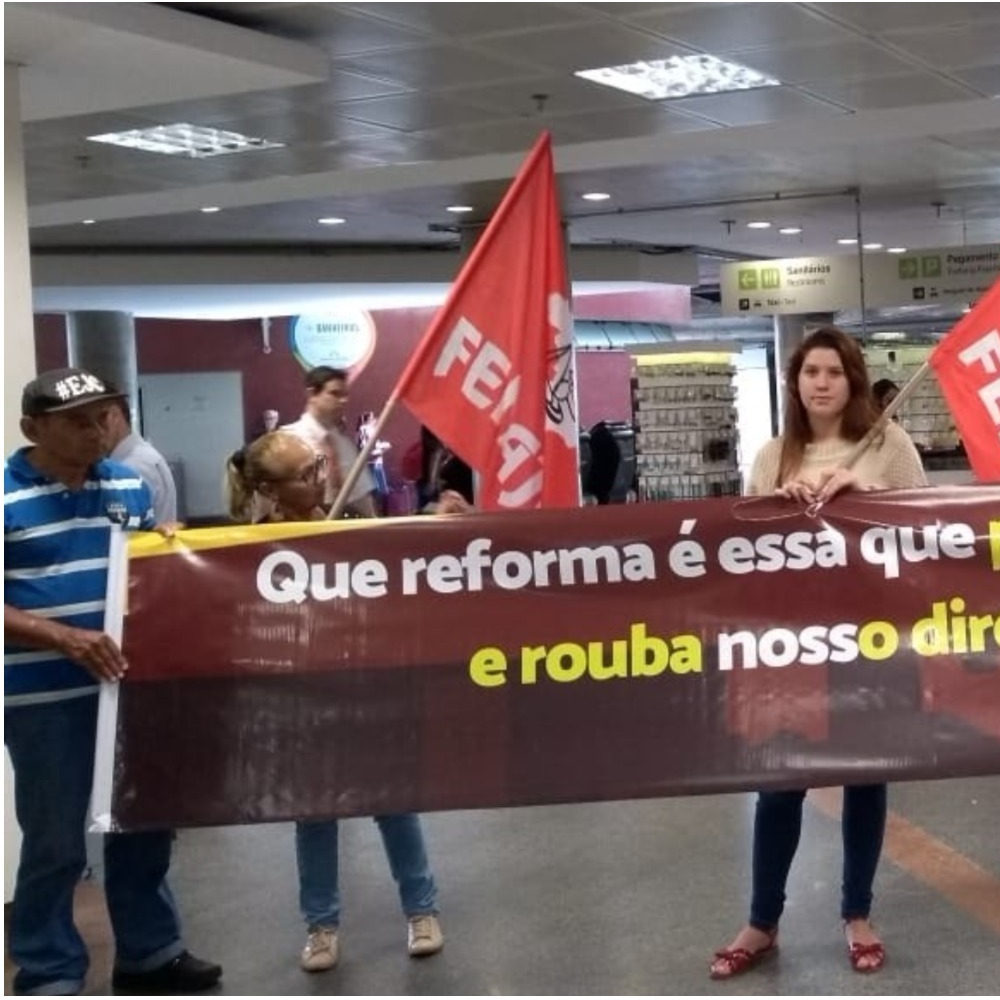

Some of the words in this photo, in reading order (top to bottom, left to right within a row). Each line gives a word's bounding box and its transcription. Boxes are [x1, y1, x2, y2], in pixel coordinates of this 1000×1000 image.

[256, 548, 387, 604] Que
[402, 538, 656, 594] reforma
[669, 518, 706, 578] é
[718, 526, 846, 574] essa
[860, 523, 974, 578] que
[469, 645, 507, 686] e
[520, 623, 702, 684] rouba
[717, 618, 899, 670] nosso
